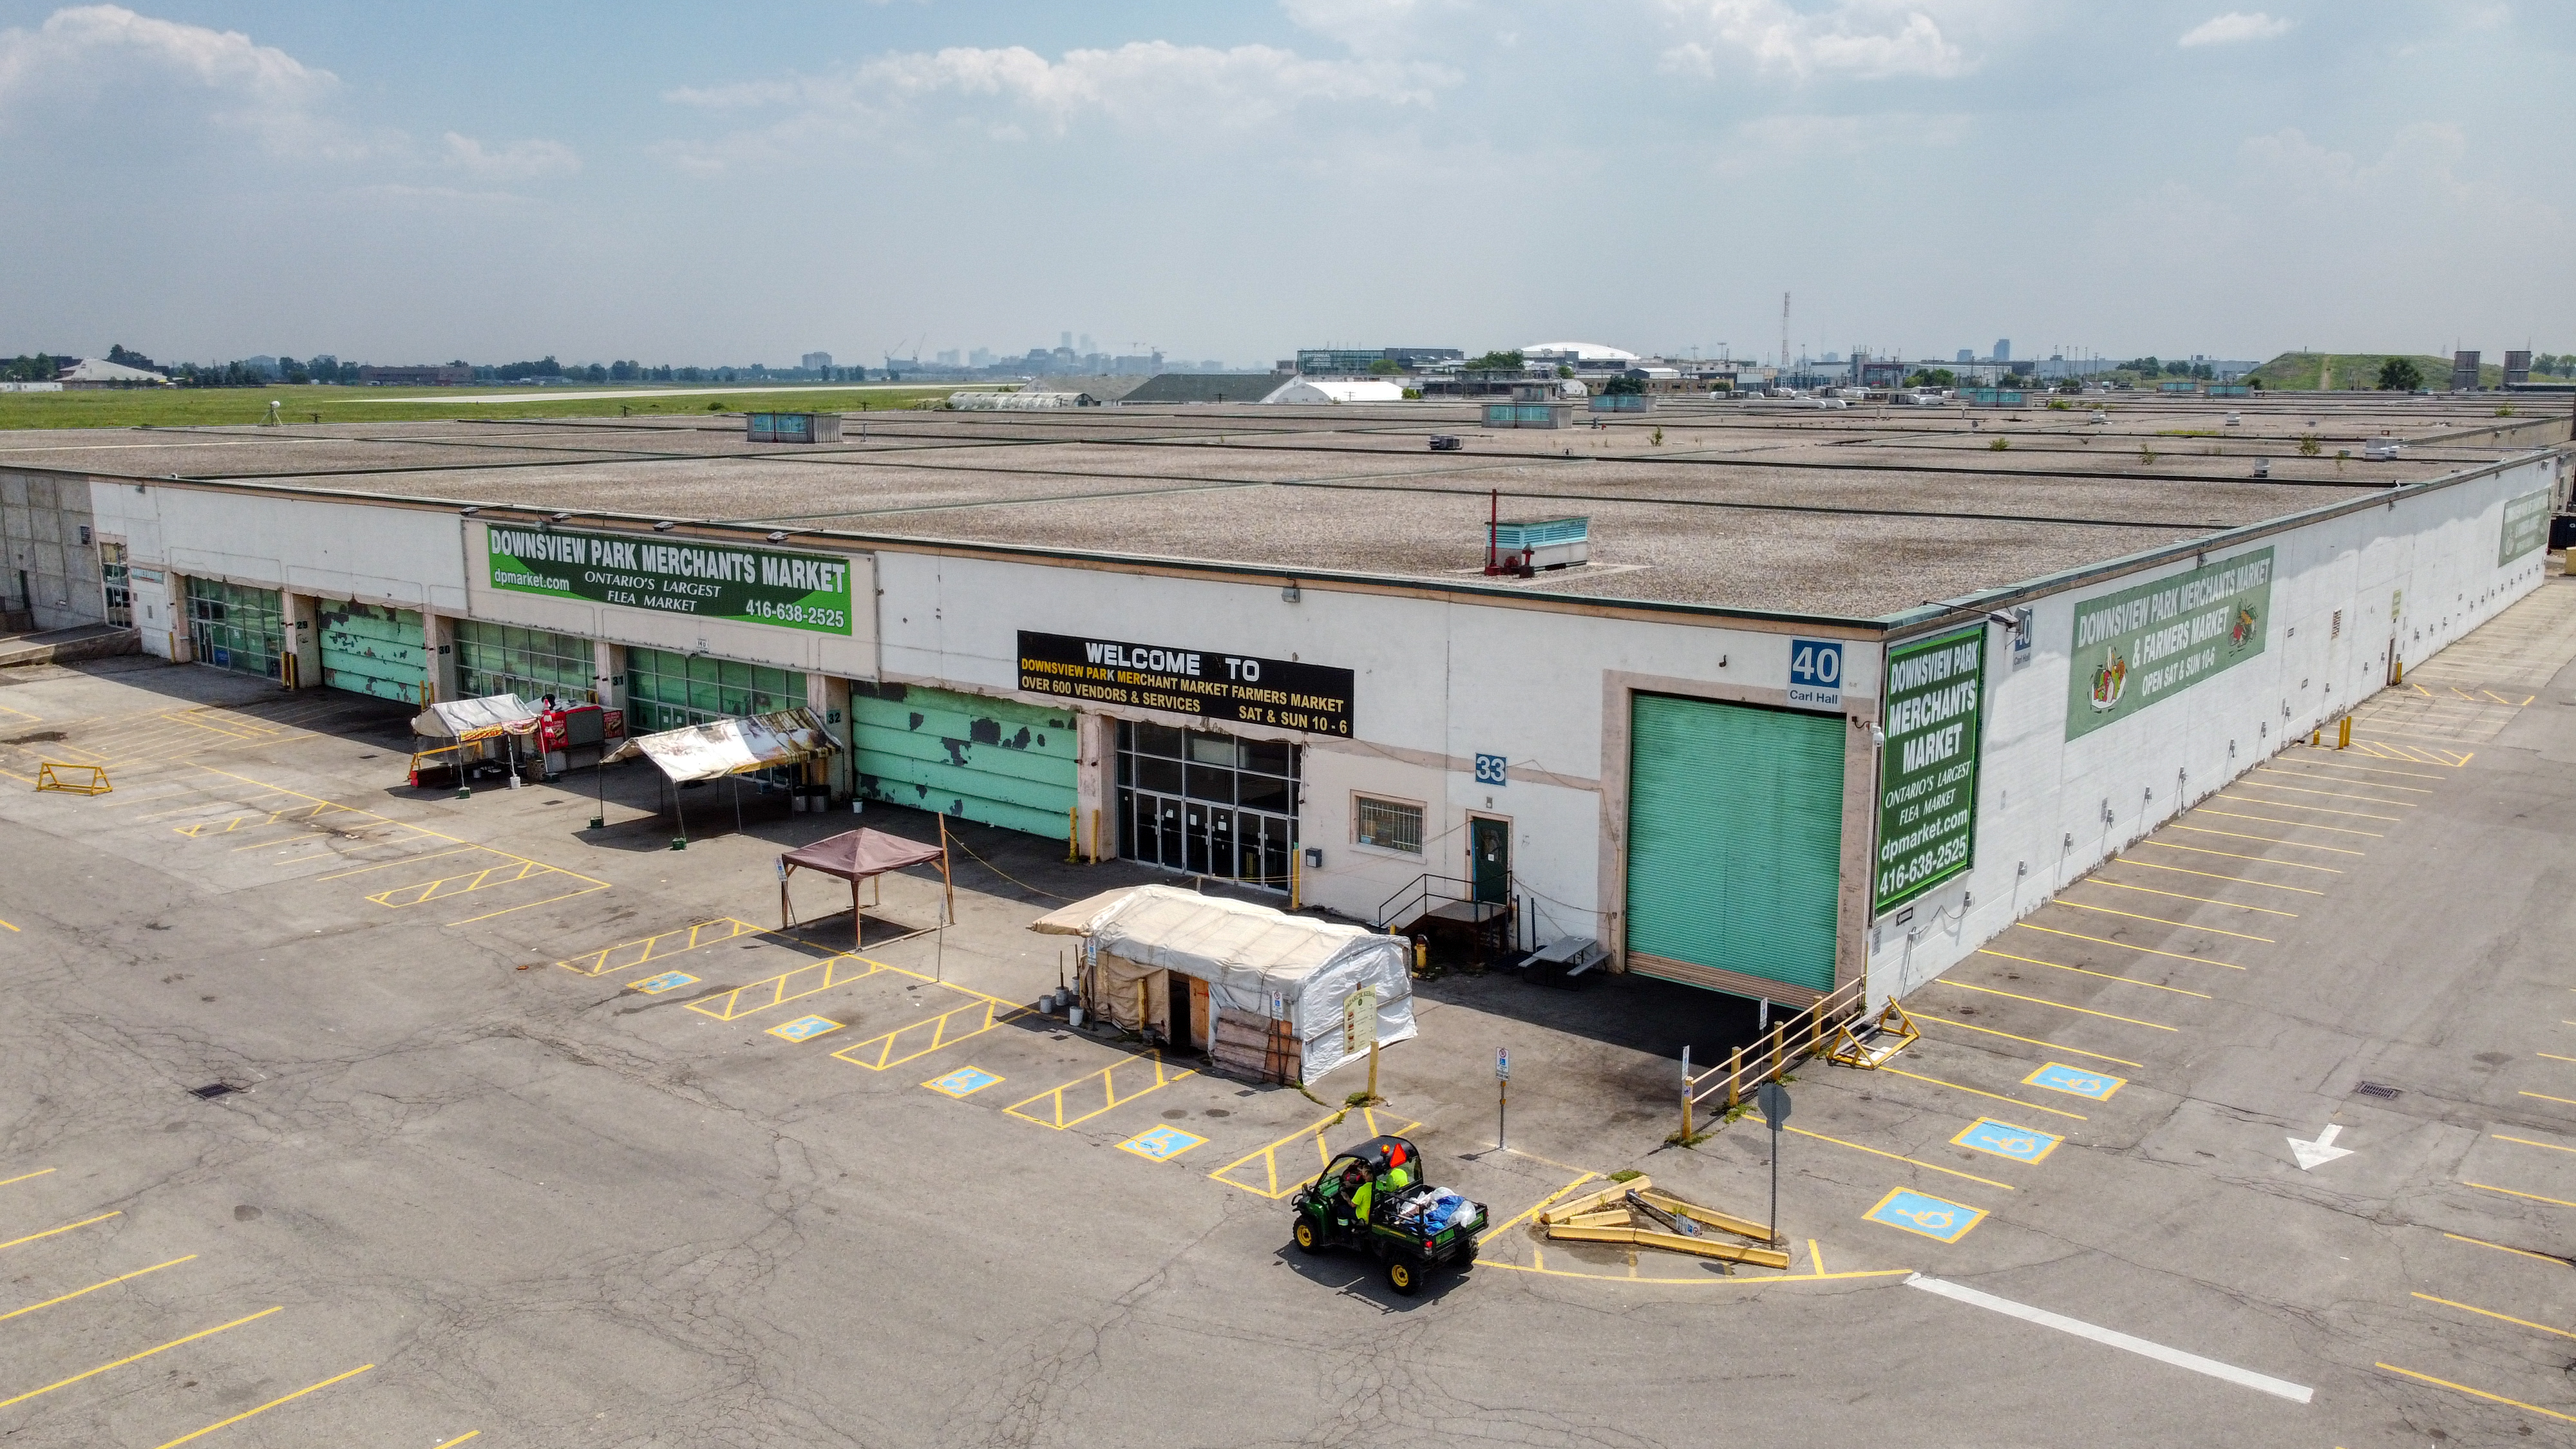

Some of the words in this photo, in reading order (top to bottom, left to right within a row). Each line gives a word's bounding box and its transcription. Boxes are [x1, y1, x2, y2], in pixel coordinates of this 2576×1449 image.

[490, 529, 585, 564] DOWNSVIEW
[591, 540, 638, 570] PARK
[642, 545, 755, 583] MERCHANTS
[762, 556, 845, 593] MARKET
[494, 568, 569, 591] dpmarket.com
[585, 571, 655, 590] ONTARIO'S
[663, 580, 722, 598] LARGEST
[607, 591, 636, 605] FLEA
[644, 595, 697, 612] MARKET
[2078, 596, 2150, 648] DOWNSVIEW
[2151, 587, 2178, 623] PARK
[2180, 569, 2235, 613] MERCHANTS
[2236, 558, 2271, 593] MARKET
[297, 621, 308, 629] 29
[746, 600, 844, 627] 416-638-2525
[439, 645, 450, 654] 30
[2132, 638, 2141, 669] &
[2143, 620, 2190, 665] FARMERS
[2190, 605, 2230, 646] MARKET
[612, 676, 623, 685] 31
[1085, 642, 1200, 676] WELCOME
[1225, 658, 1260, 682] TO
[1792, 646, 1839, 683] 40
[1890, 648, 1953, 695] DOWNSVIEW
[1954, 640, 1979, 676] PARK
[2142, 670, 2163, 697] OPEN
[2163, 662, 2179, 687] SAT
[2179, 659, 2184, 681] &
[2186, 653, 2201, 677] SUN
[2201, 647, 2215, 671] 10-6
[1021, 658, 1084, 677] DOWNSVIEW
[1086, 667, 1115, 682] PARK
[1117, 670, 1178, 690] MERCHANT
[1180, 679, 1228, 697] MARKET
[1232, 685, 1287, 705] FARMERS
[1291, 693, 1344, 713] MARKET
[1021, 676, 1050, 692] OVER
[1052, 680, 1071, 694] 600
[1074, 683, 1127, 703] VENDORS
[1130, 690, 1140, 704] &
[1142, 691, 1200, 712] SERVICES
[1238, 705, 1262, 721] SAT
[1267, 709, 1276, 723] &
[1280, 711, 1308, 728] SUN
[1312, 715, 1327, 731] 10
[1339, 719, 1347, 734] 6
[1790, 690, 1813, 701] Carl
[1816, 692, 1837, 705] Hall
[829, 712, 840, 724] 32
[1888, 678, 1976, 738] MERCHANTS
[1903, 722, 1963, 774] MARKET
[1476, 756, 1505, 782] 33
[1885, 775, 1934, 808] ONTARIO'S
[1937, 761, 1971, 787] LARGEST
[1899, 804, 1919, 826] FLEA
[1922, 788, 1956, 816] MARKET
[1881, 809, 1968, 862] dpmarket.com
[1879, 834, 1966, 896] 416-638-2525
